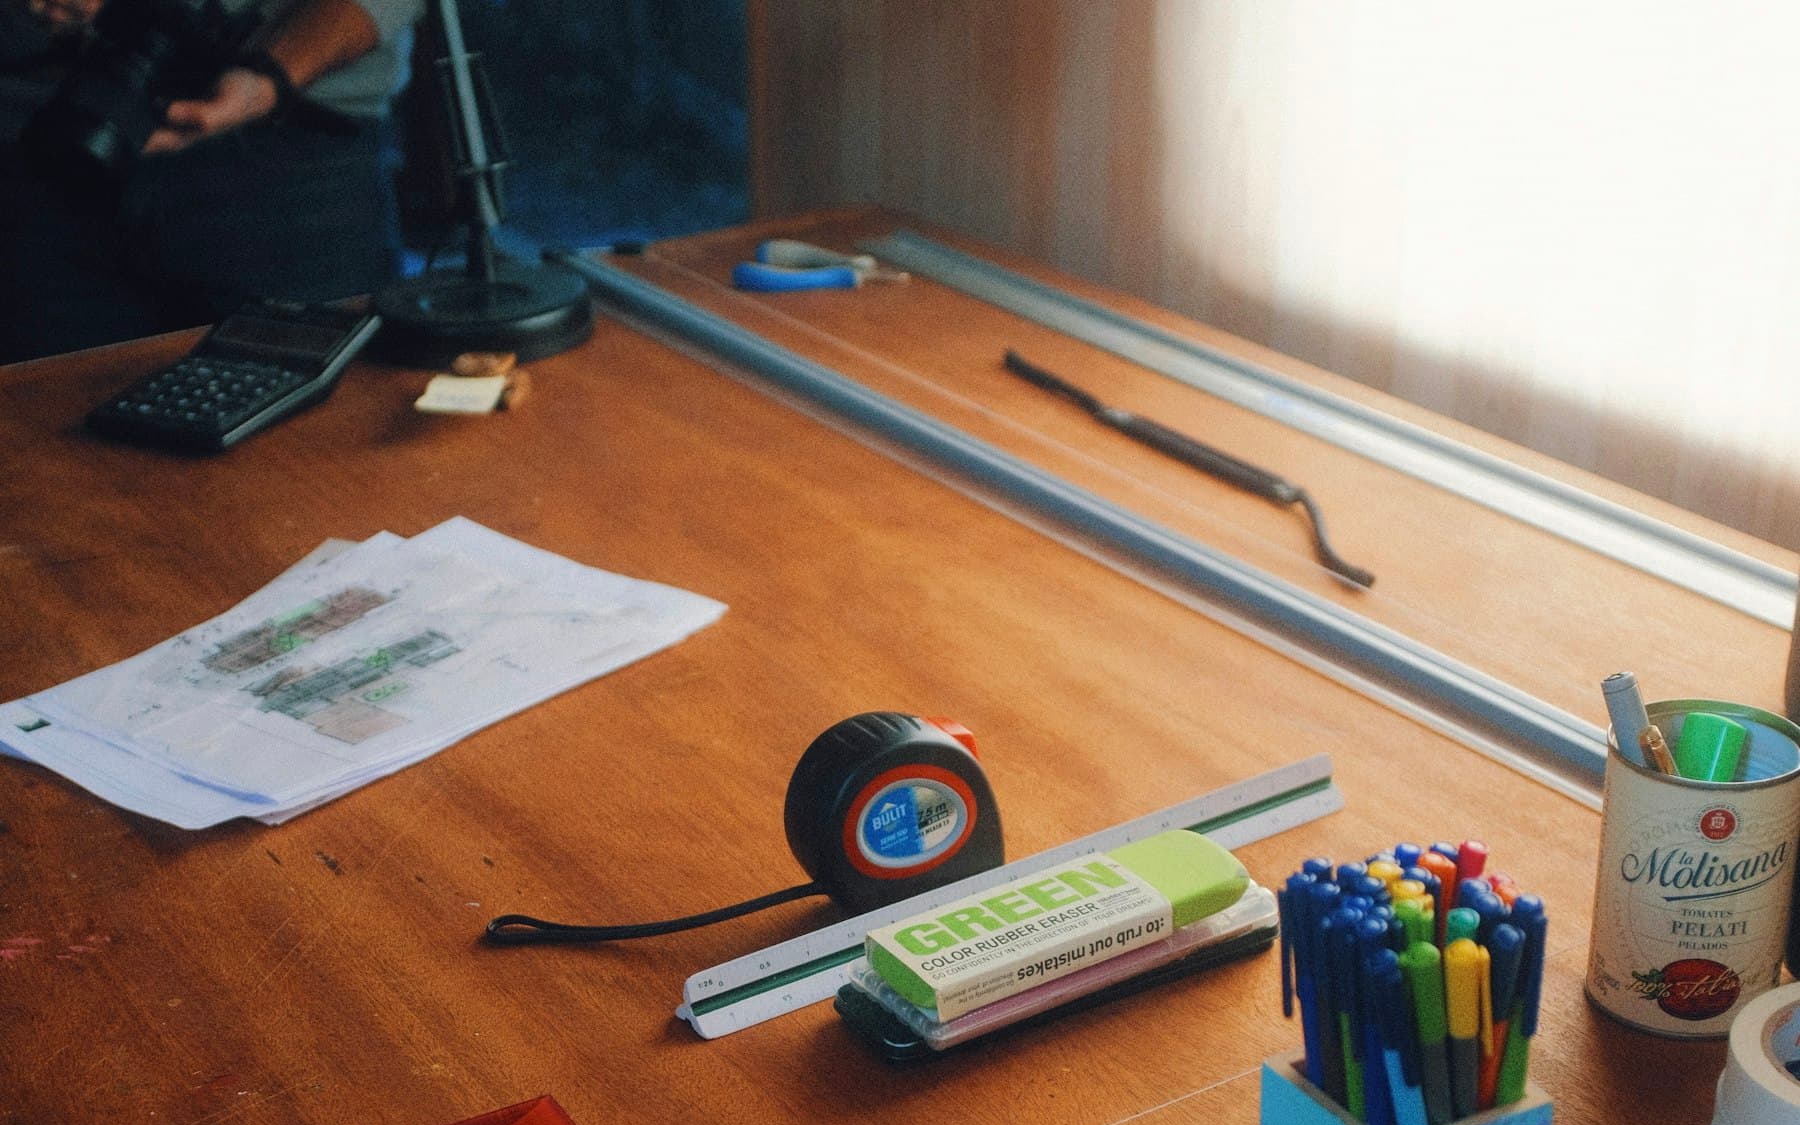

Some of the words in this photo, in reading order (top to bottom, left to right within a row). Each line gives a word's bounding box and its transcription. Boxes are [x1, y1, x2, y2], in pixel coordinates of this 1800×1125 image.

[872, 803, 907, 831] BULIT
[1621, 841, 1787, 888] Molisana
[1679, 851, 1694, 865] la
[893, 861, 1128, 956] GREEN
[1681, 908, 1734, 918] TOMATES
[921, 946, 976, 972] COLOR
[975, 923, 1039, 952] RUBBER
[1040, 902, 1100, 929] ERASER
[1034, 923, 1078, 943] DIRECTION
[1116, 925, 1142, 946] rub
[1671, 919, 1747, 937] PELATI
[1089, 936, 1113, 956] out
[1678, 941, 1728, 950] PELADOS
[1017, 946, 1086, 980] mistakes
